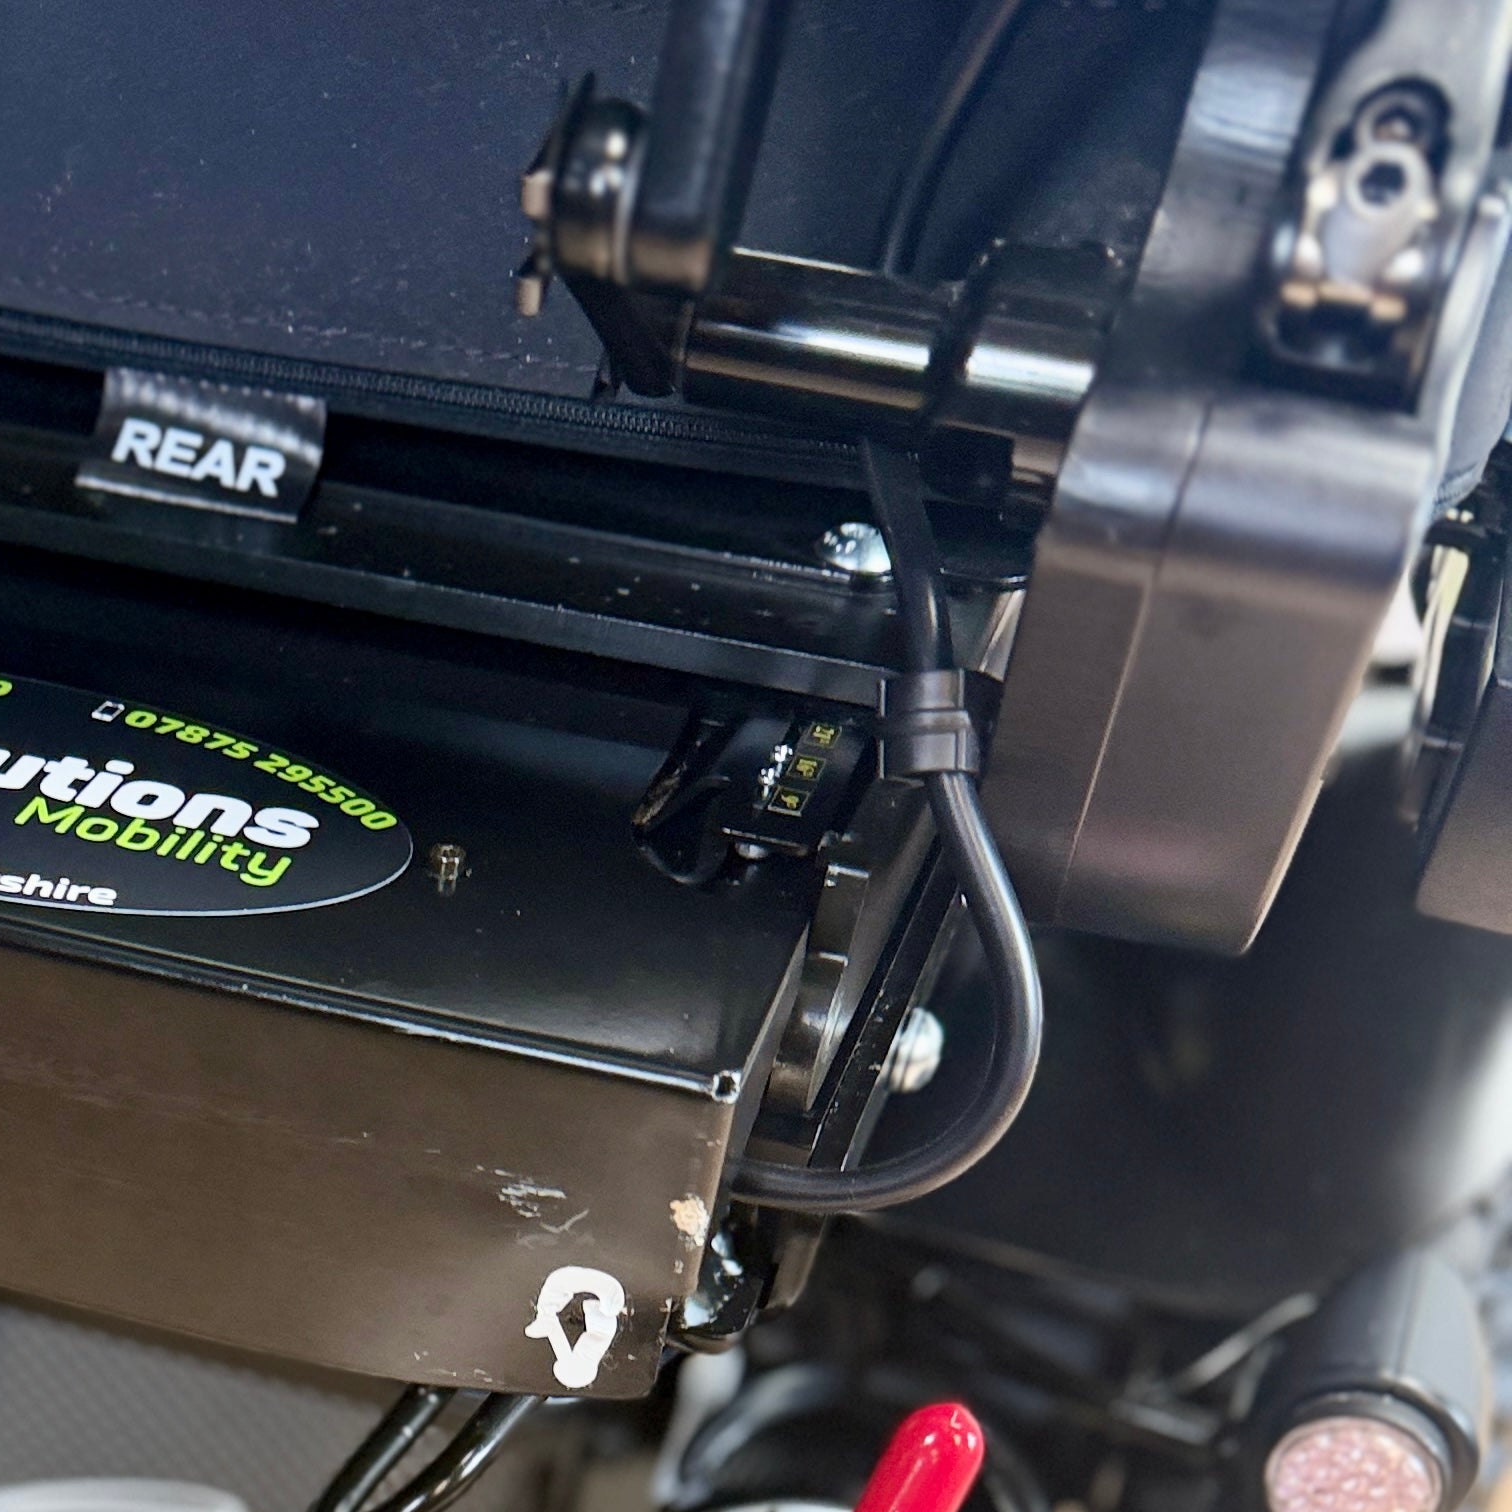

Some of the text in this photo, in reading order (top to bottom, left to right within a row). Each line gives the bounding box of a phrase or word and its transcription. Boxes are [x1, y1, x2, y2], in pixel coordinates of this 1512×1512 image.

[111, 417, 286, 497] REAR
[124, 709, 397, 830] 07875 295500
[14, 796, 292, 887] Mobility
